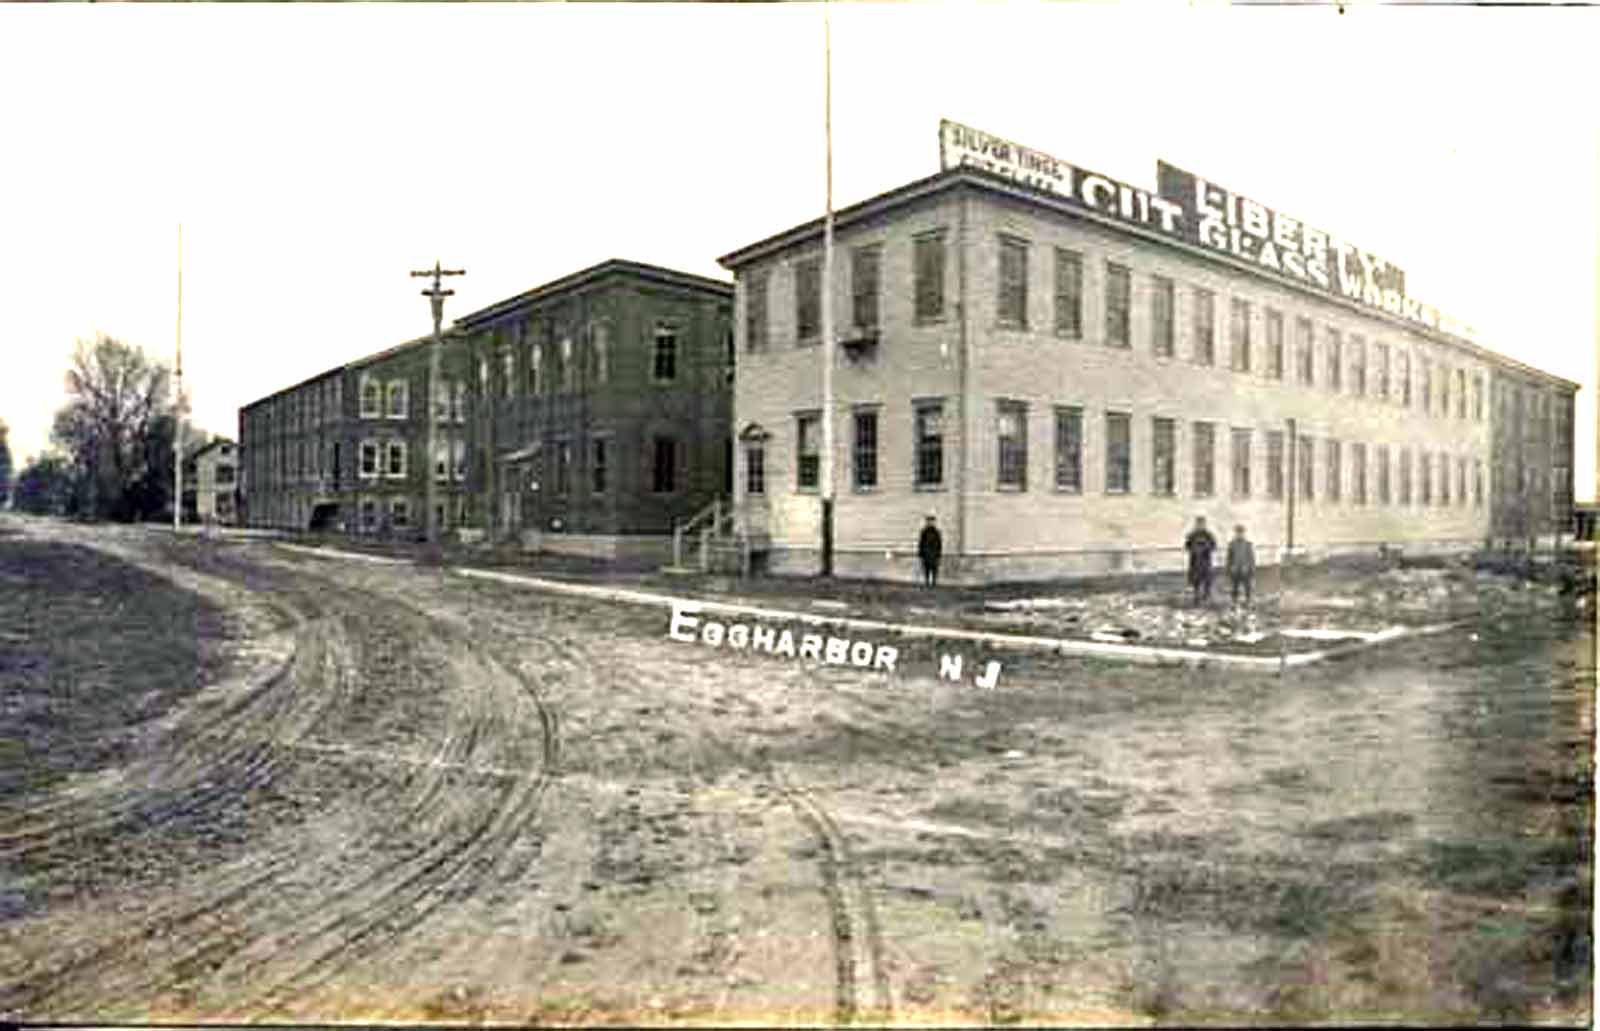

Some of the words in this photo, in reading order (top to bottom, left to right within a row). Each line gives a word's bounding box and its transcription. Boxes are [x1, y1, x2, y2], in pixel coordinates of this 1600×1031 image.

[1081, 175, 1183, 232] CUT
[1200, 212, 1329, 287] GLASS
[1195, 177, 1392, 278] LIBERTY
